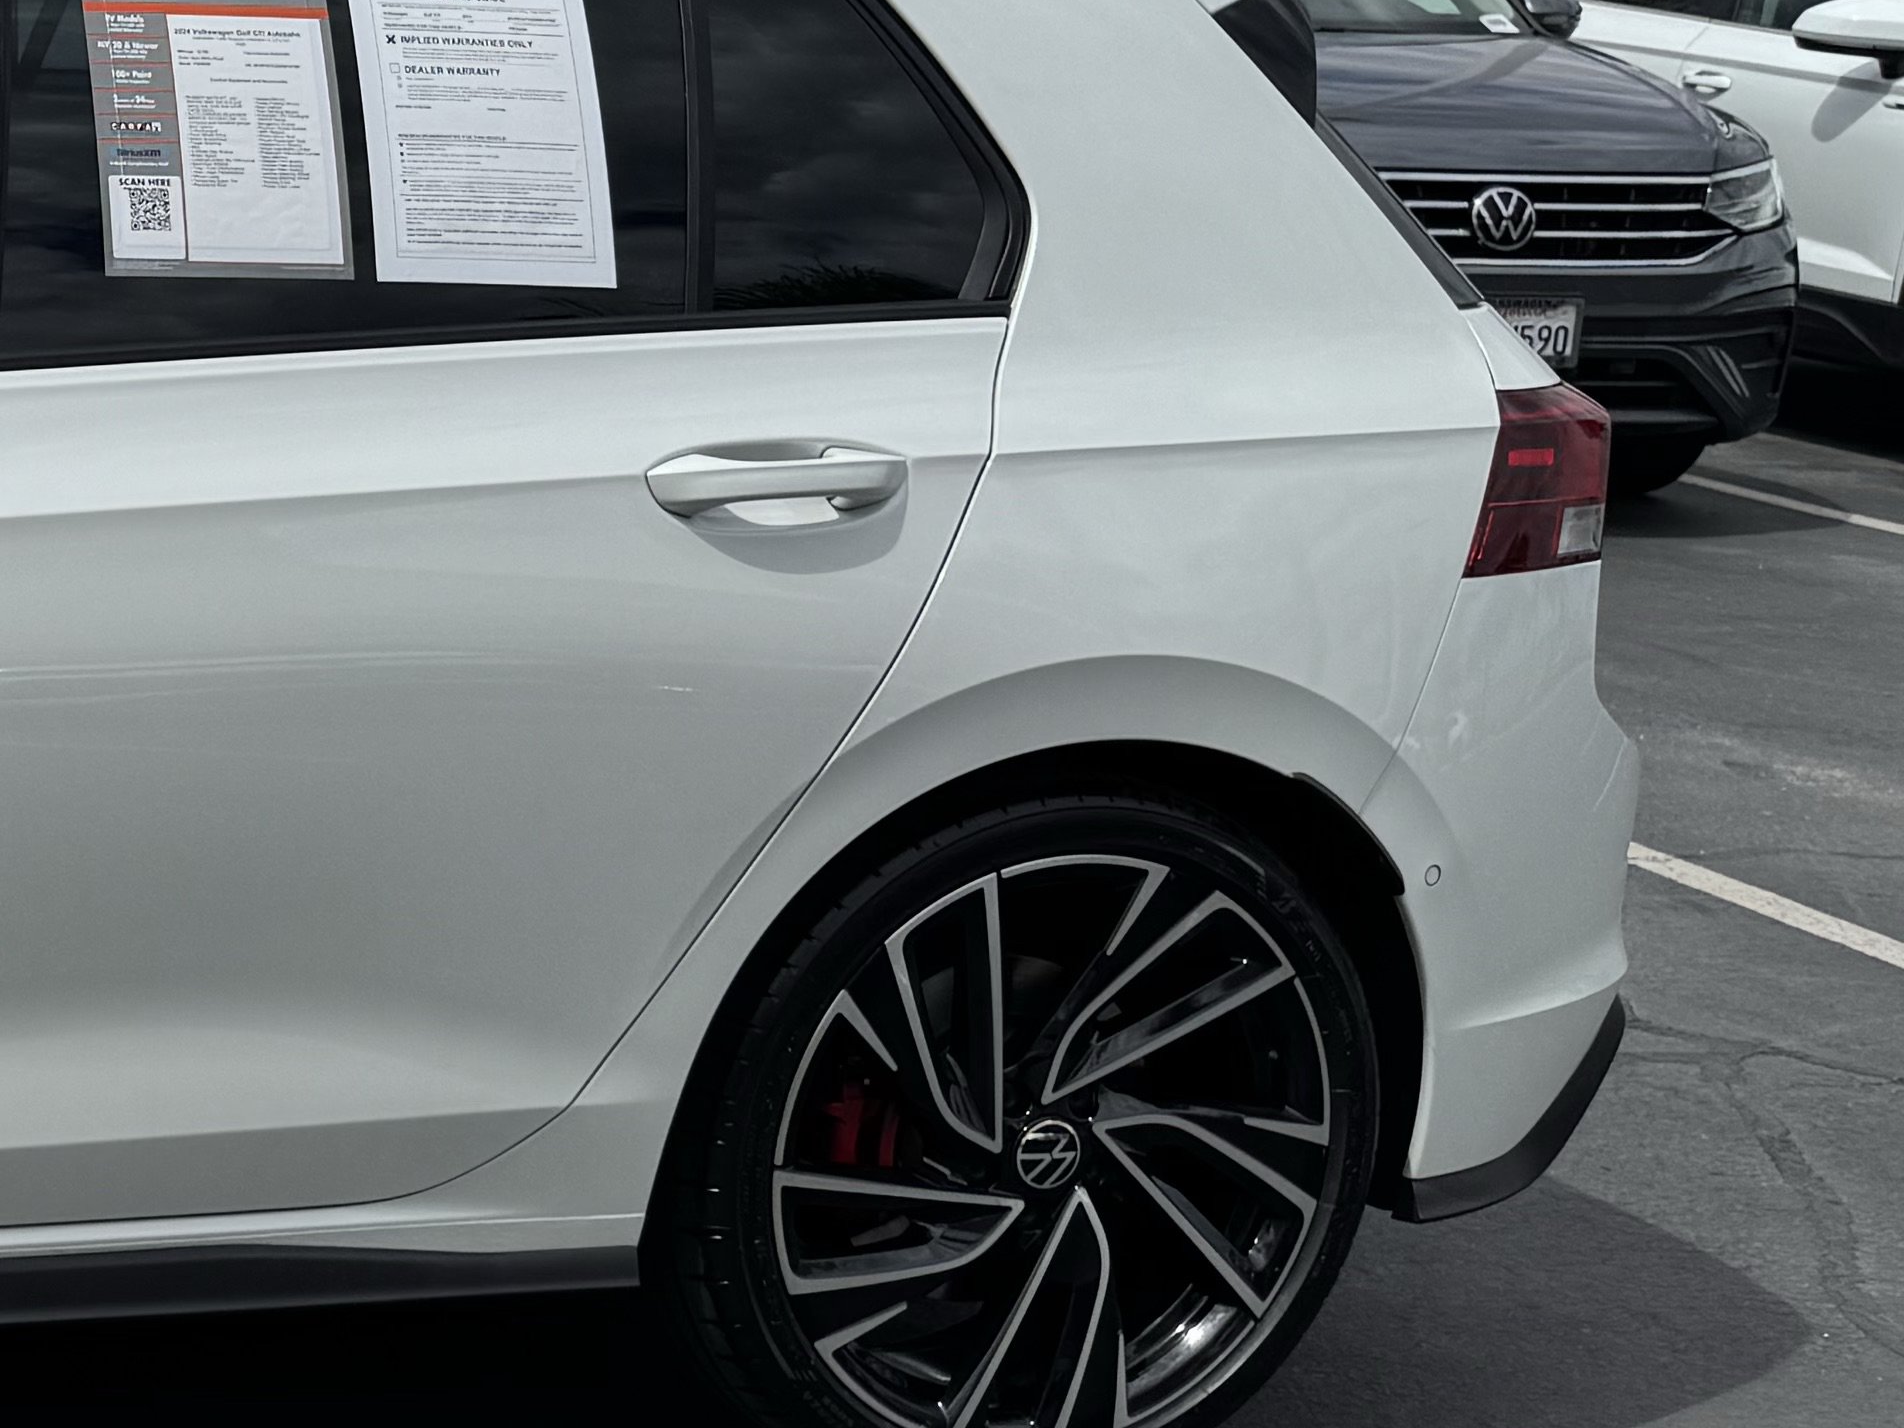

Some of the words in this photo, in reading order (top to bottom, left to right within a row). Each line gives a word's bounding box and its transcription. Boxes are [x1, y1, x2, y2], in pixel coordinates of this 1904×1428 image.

[400, 36, 440, 46] IMPLIED
[442, 37, 506, 48] WARRANTIES
[507, 39, 533, 49] ONLY
[404, 65, 443, 75] DEALER
[447, 66, 501, 77] WARRANTY
[119, 178, 145, 186] SCAN
[148, 178, 171, 187] HERE
[1513, 325, 1569, 355] 590
